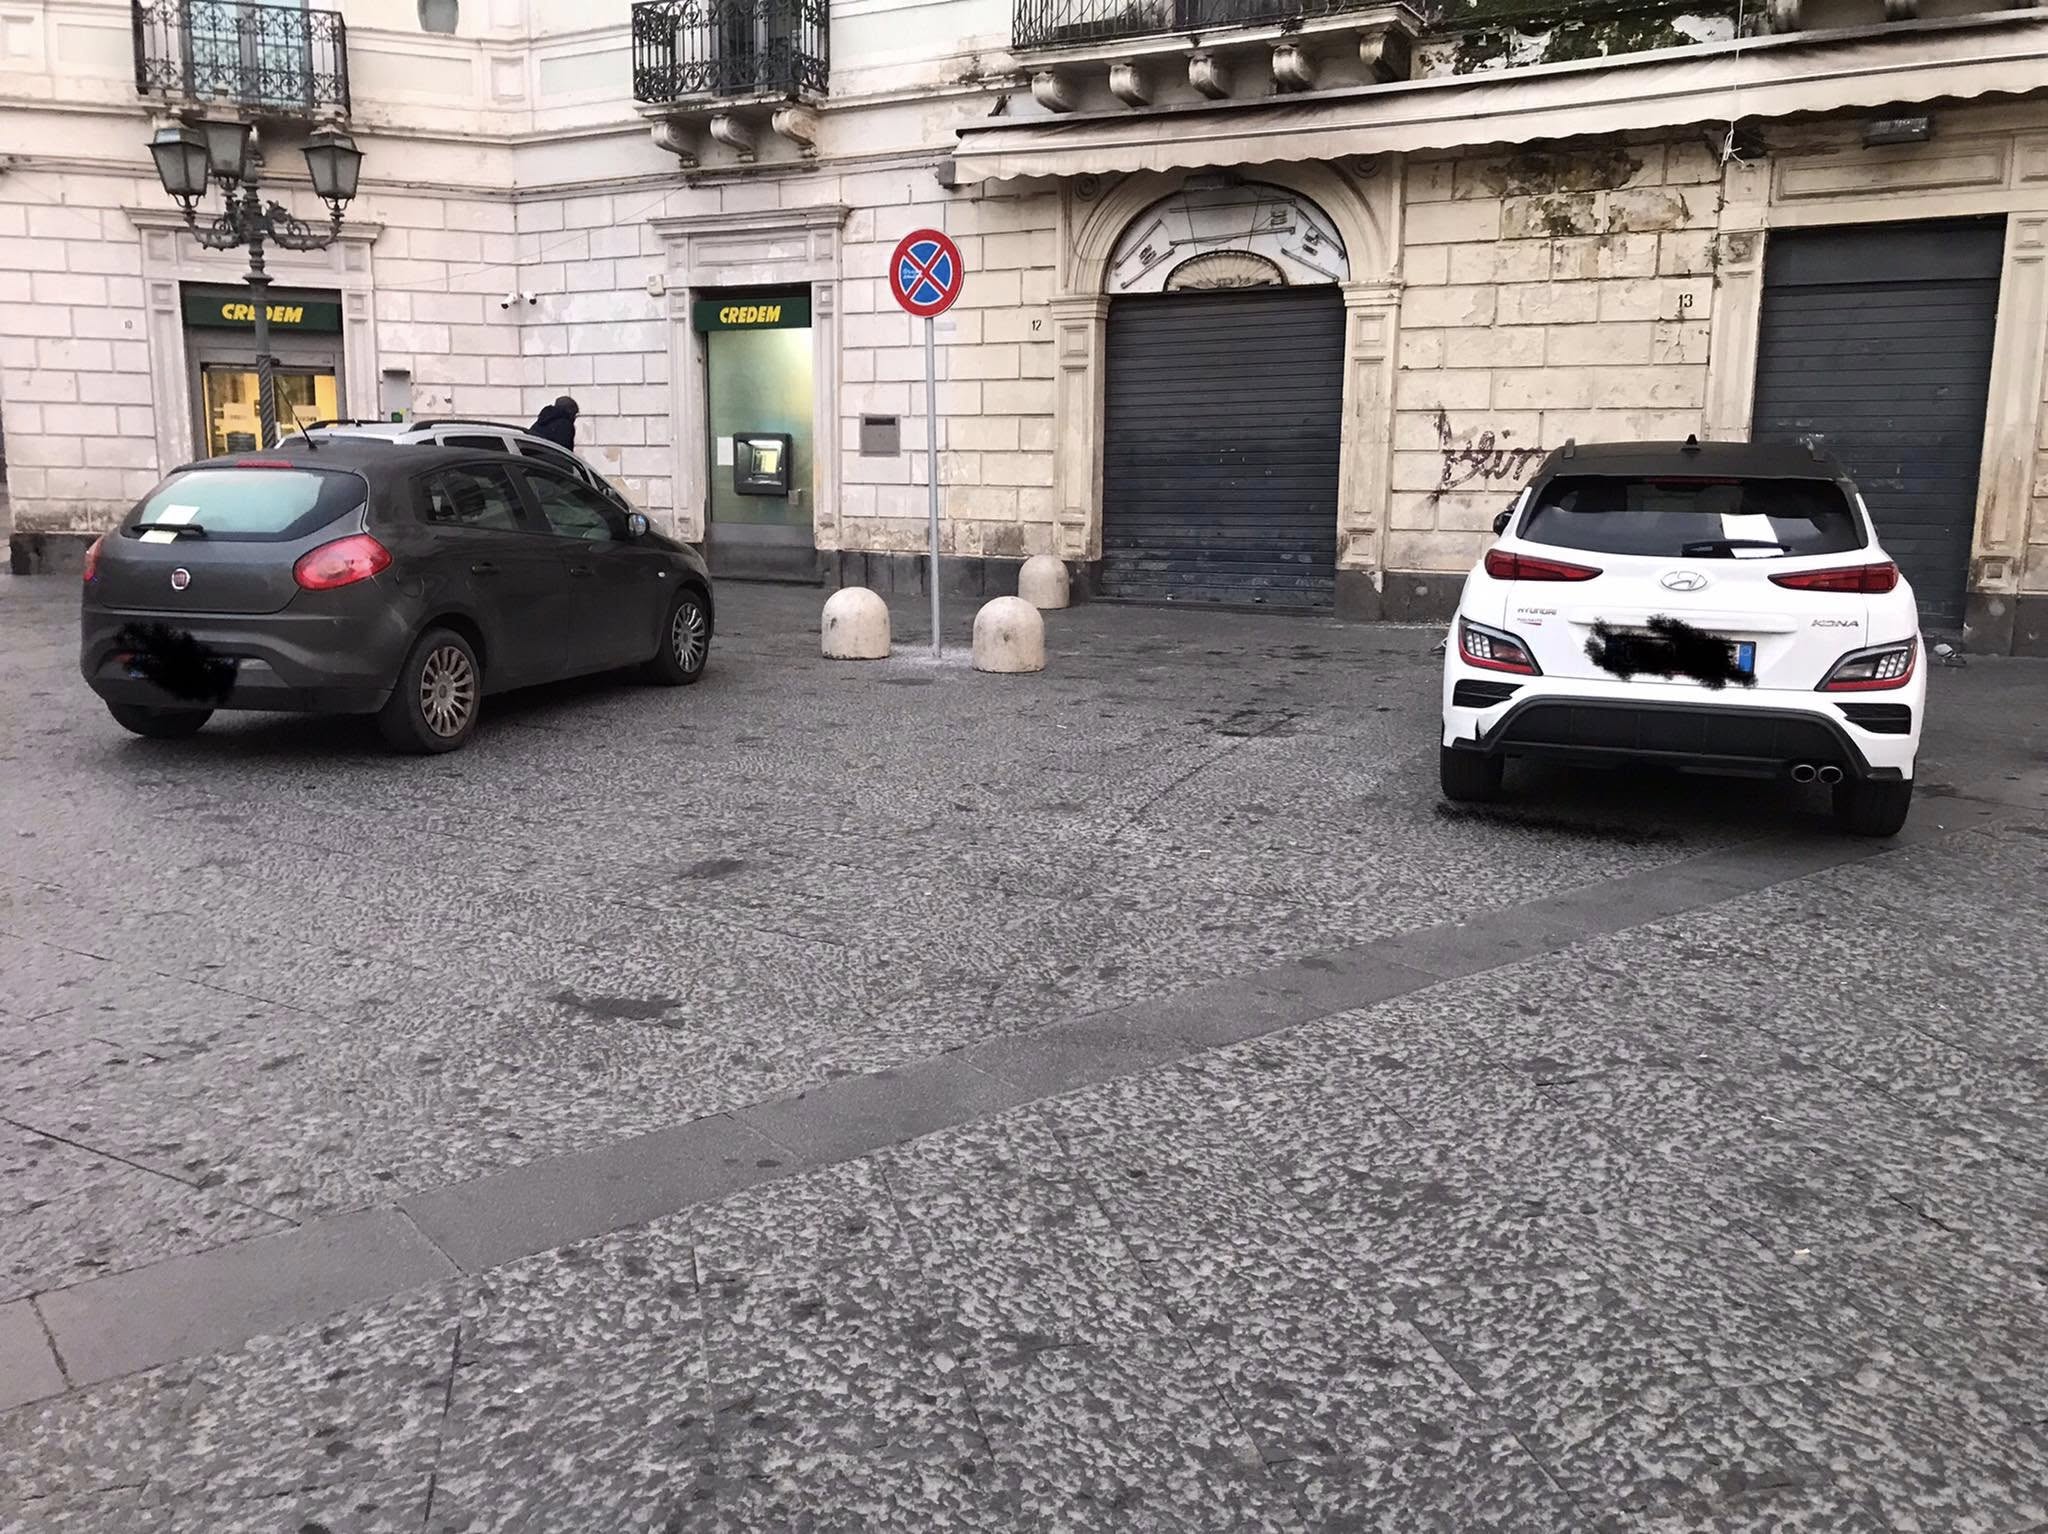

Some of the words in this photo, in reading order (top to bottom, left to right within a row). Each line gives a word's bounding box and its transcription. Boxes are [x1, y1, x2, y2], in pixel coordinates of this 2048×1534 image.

[1679, 294, 1693, 308] 13
[719, 305, 781, 324] CREDEM
[1811, 619, 1859, 628] KONA
